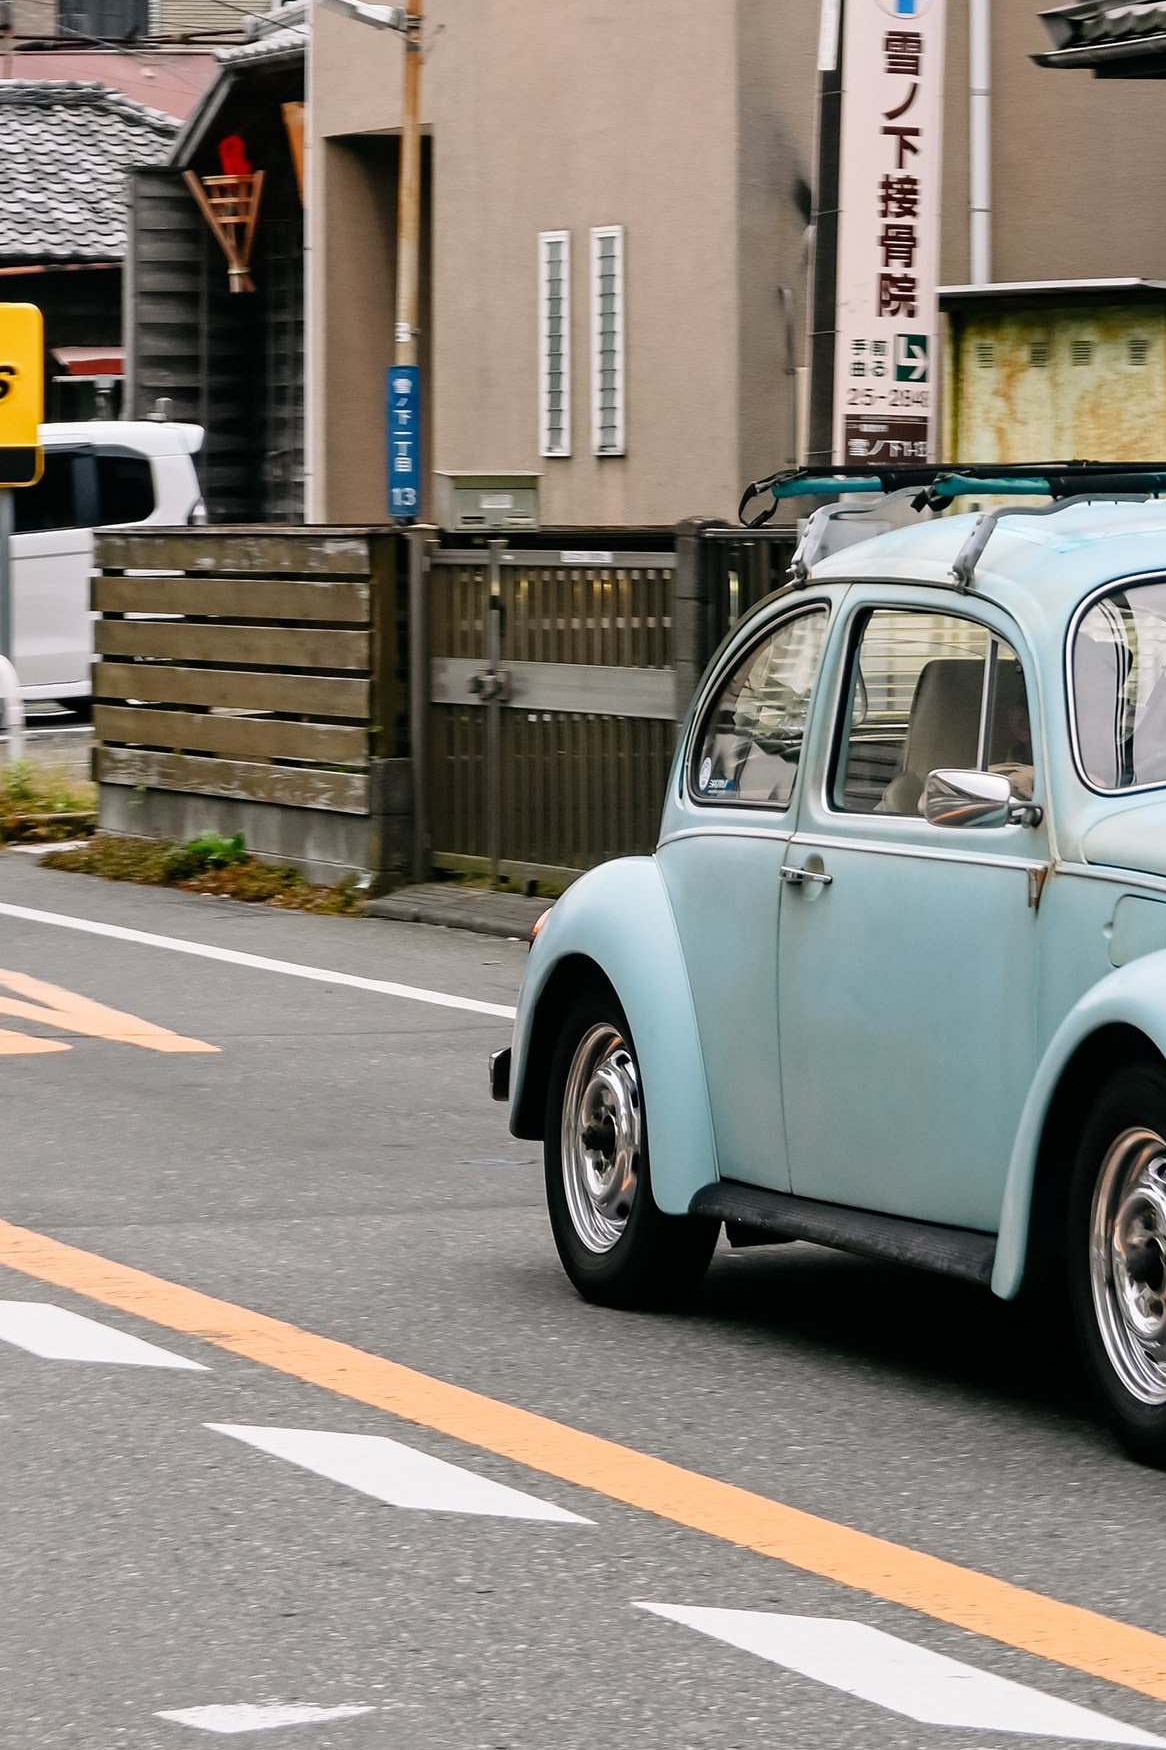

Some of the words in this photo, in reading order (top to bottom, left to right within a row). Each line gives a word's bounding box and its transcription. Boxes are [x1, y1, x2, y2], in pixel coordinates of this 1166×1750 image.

[875, 30, 924, 318] 雪ノ下接骨院
[392, 378, 413, 472] 雪ノ下一丁目
[391, 487, 416, 506] 13
